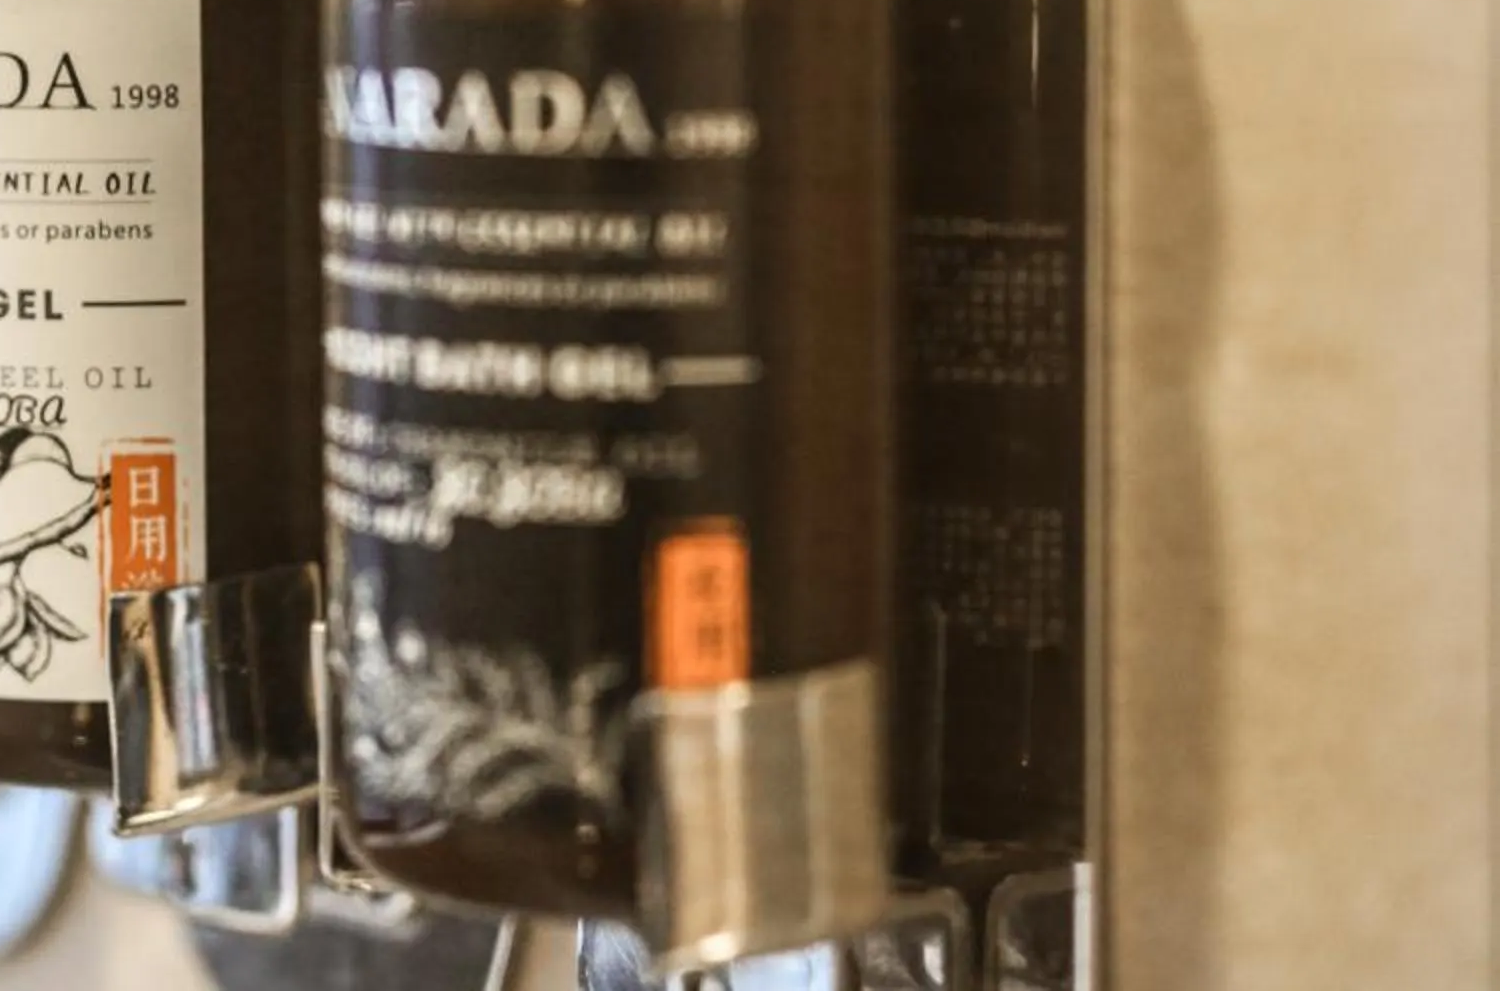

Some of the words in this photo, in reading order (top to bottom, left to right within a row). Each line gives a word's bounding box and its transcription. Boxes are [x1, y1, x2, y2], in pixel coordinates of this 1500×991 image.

[111, 83, 180, 110] 1998
[104, 171, 157, 196] OIL
[16, 222, 39, 240] or
[45, 218, 154, 244] parabens
[84, 365, 154, 390] OIL
